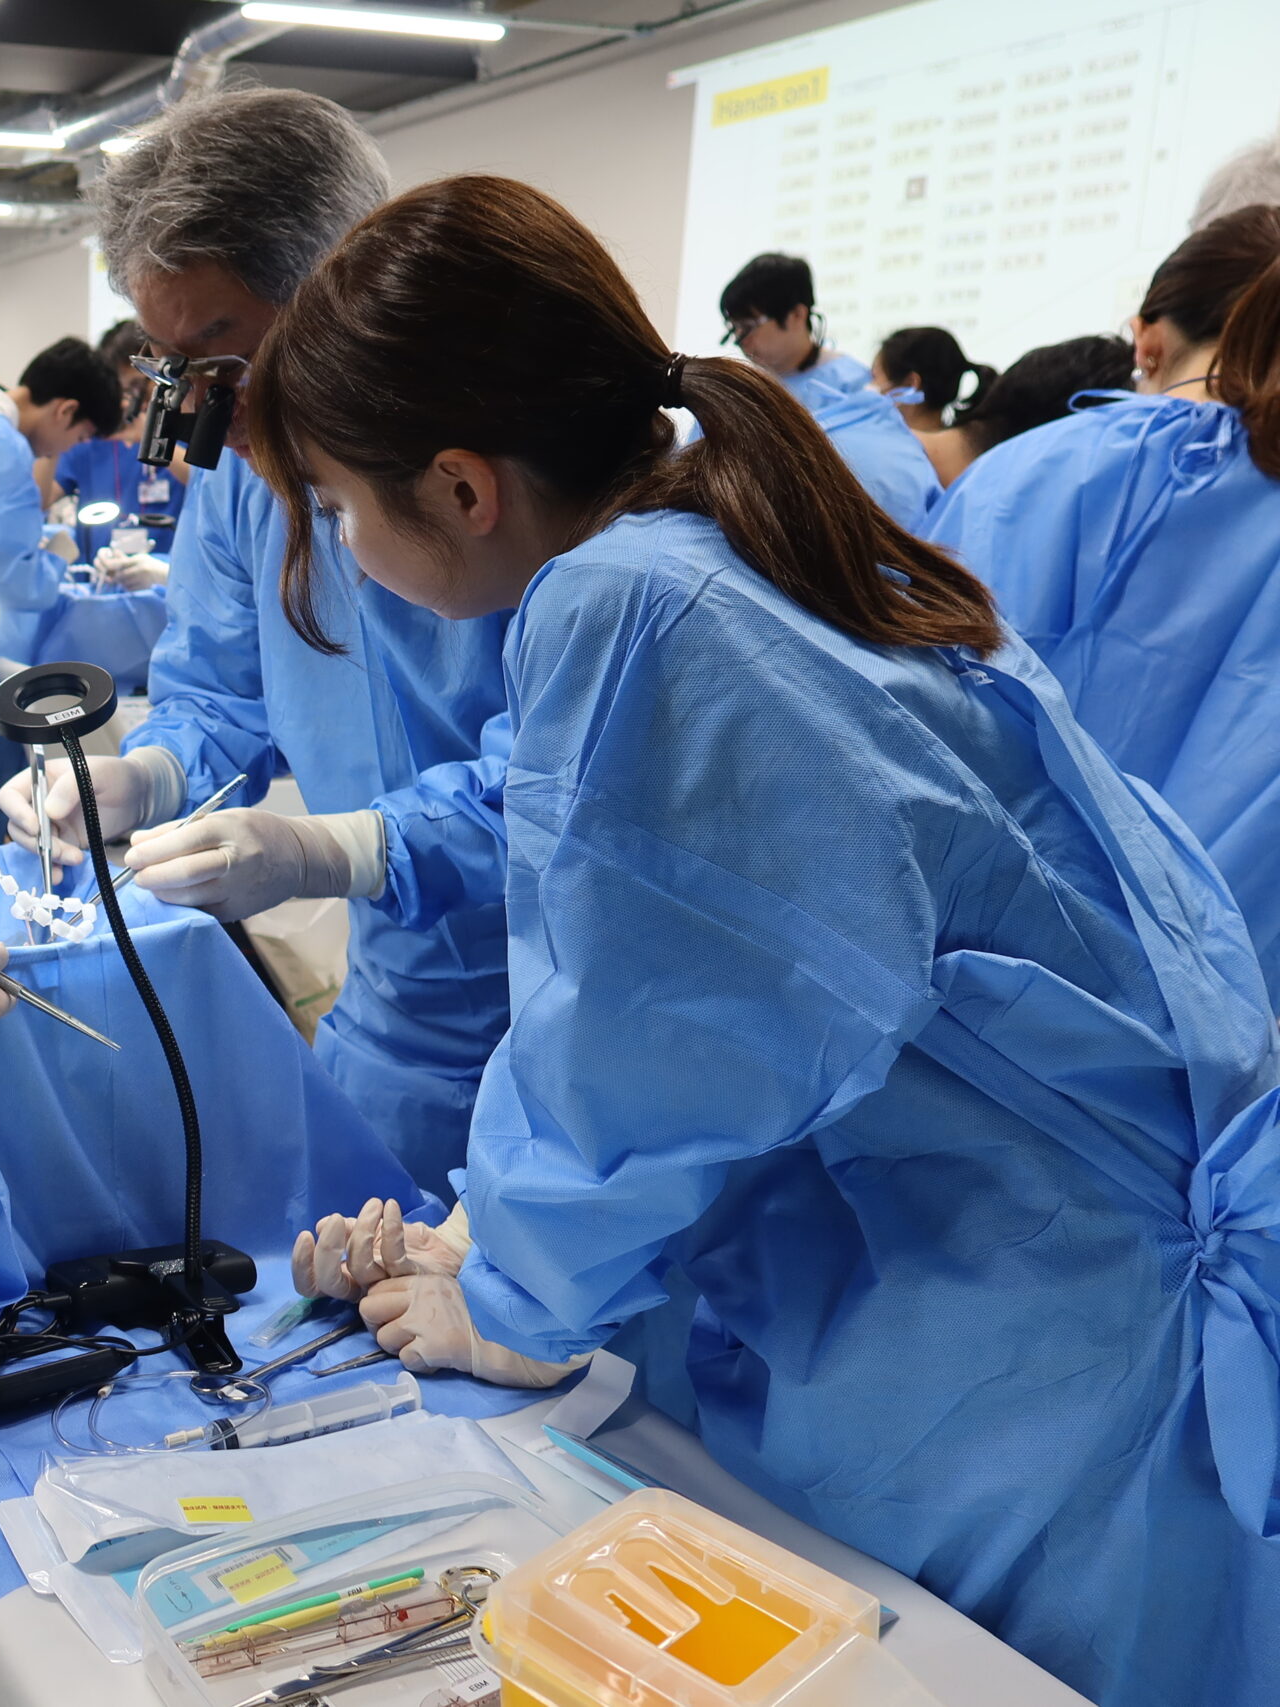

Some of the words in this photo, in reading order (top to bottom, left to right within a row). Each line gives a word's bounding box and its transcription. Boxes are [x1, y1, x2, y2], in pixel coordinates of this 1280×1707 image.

[718, 87, 778, 120] Hands
[54, 709, 81, 721] EBM
[468, 1679, 490, 1692] EBM
